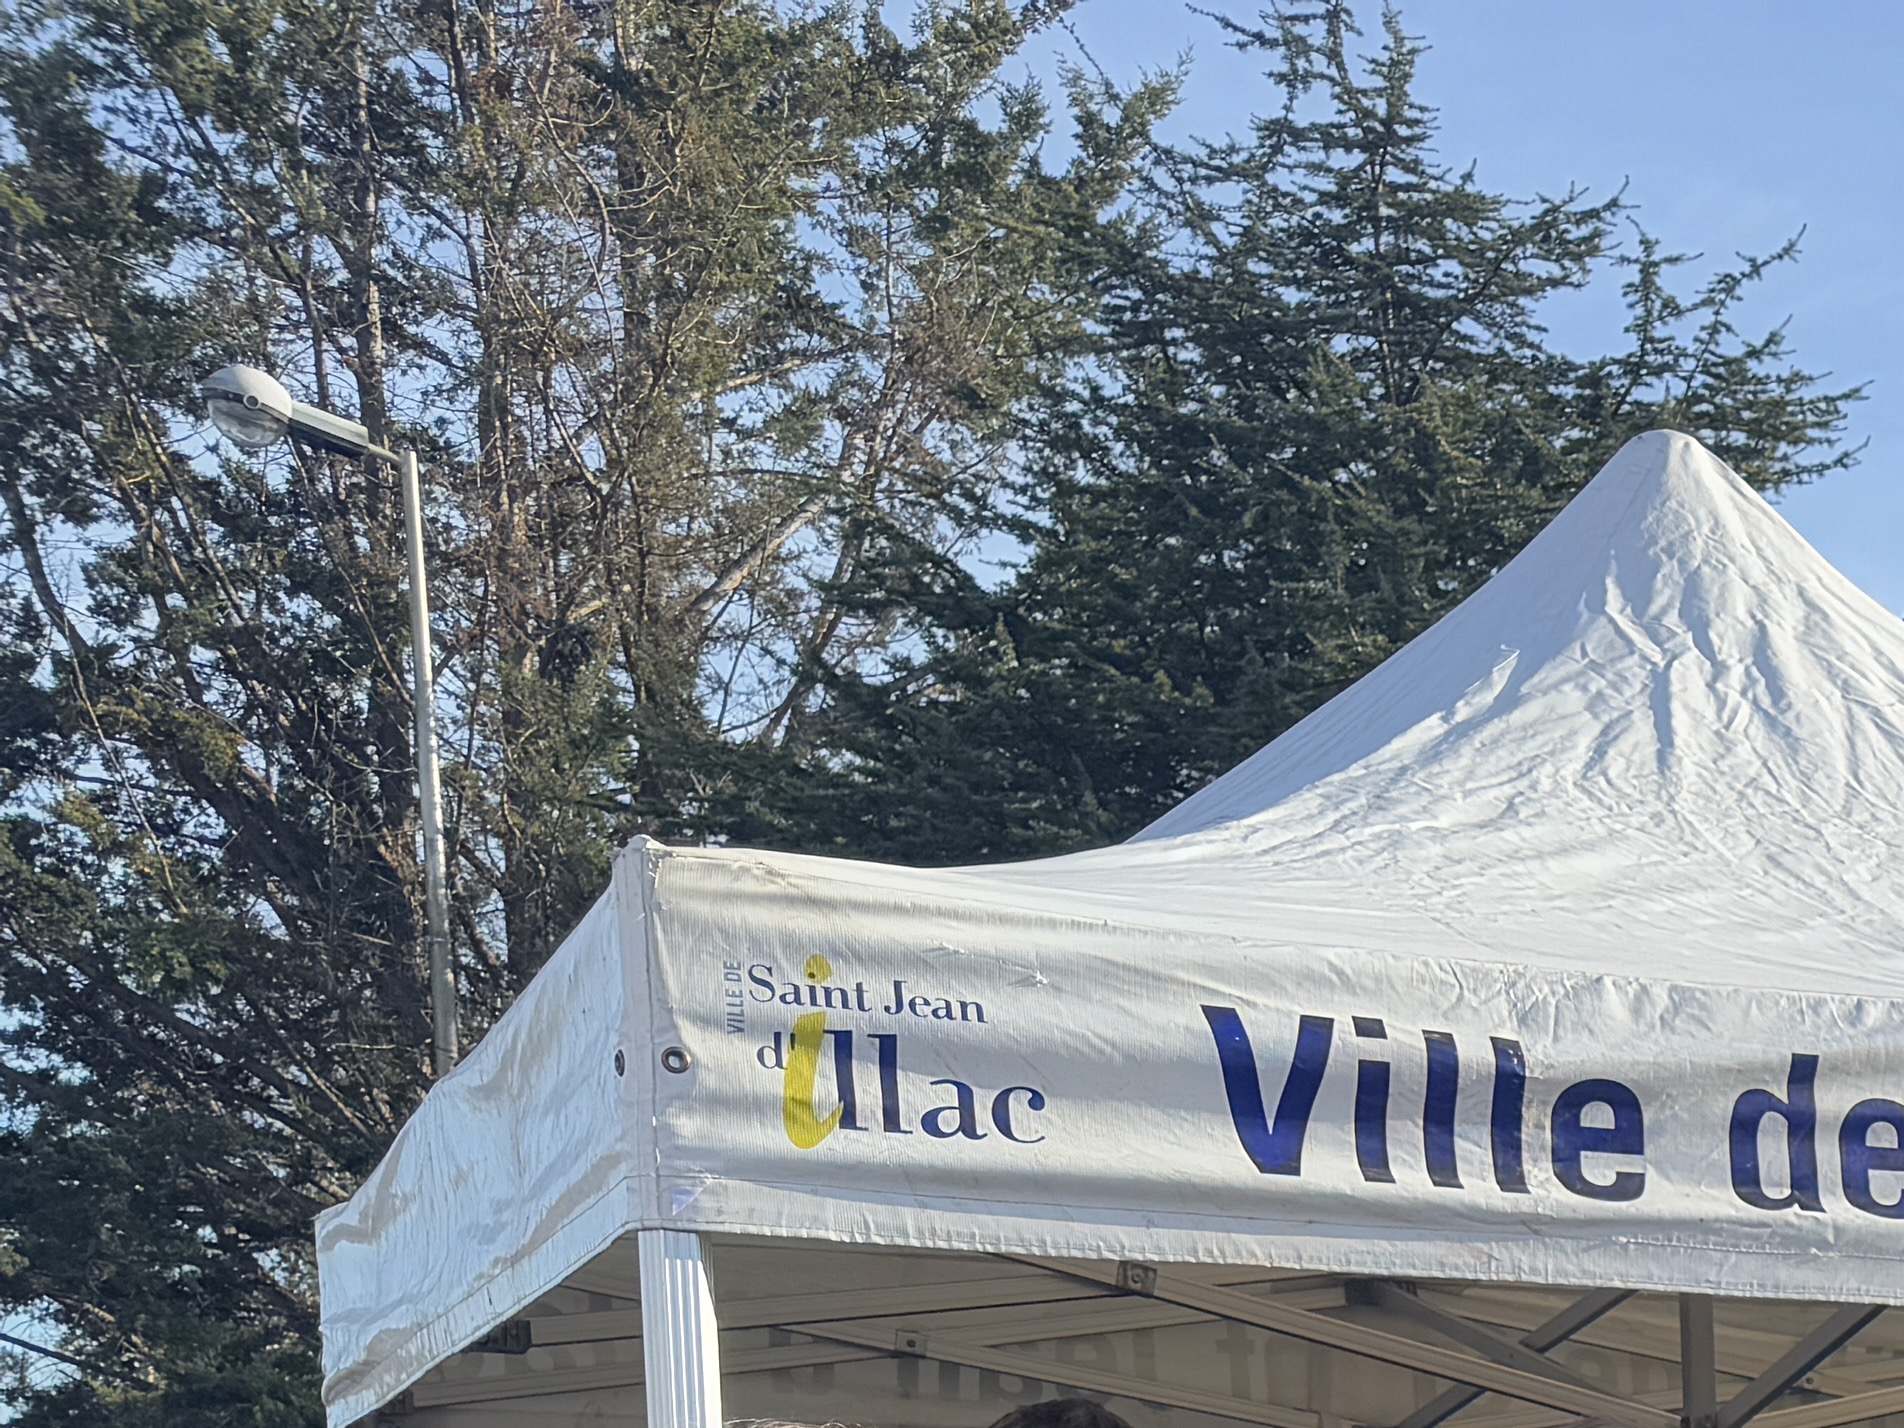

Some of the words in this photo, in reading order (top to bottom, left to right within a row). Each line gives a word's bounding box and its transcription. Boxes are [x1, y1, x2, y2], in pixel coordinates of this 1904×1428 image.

[723, 960, 743, 983] DE
[747, 963, 872, 1013] Saint
[884, 979, 989, 1025] Jean
[726, 989, 746, 1036] VILLE
[1200, 1004, 1646, 1203] Ville
